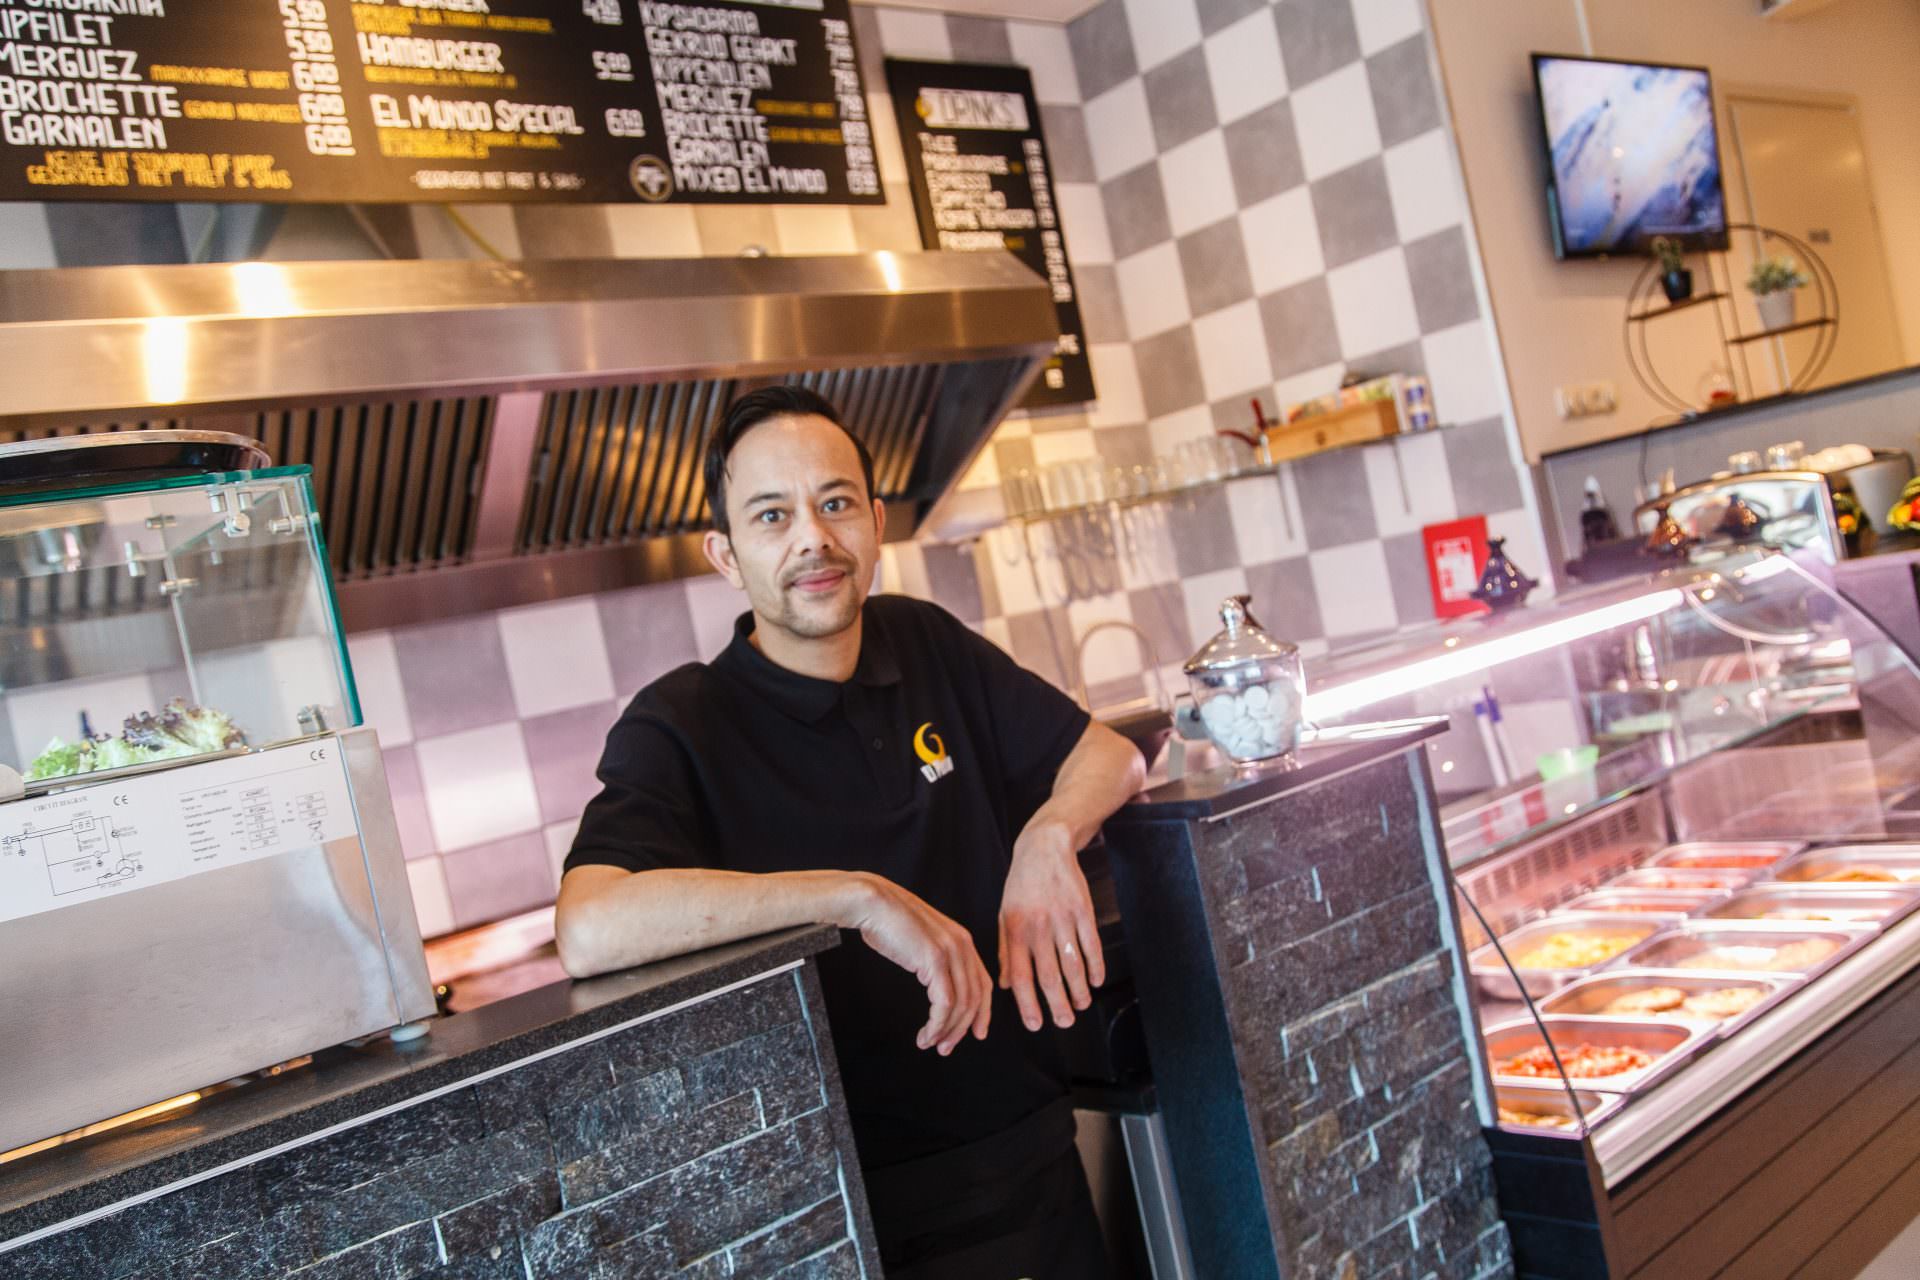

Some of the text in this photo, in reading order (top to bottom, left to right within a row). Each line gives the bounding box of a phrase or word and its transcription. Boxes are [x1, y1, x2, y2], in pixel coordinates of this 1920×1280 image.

[0, 9, 114, 46] IPFILET
[357, 31, 505, 73] HAMBURGER
[0, 75, 182, 118] BROCHETTE
[369, 94, 411, 128] EL
[2, 110, 168, 150] GARNALEN
